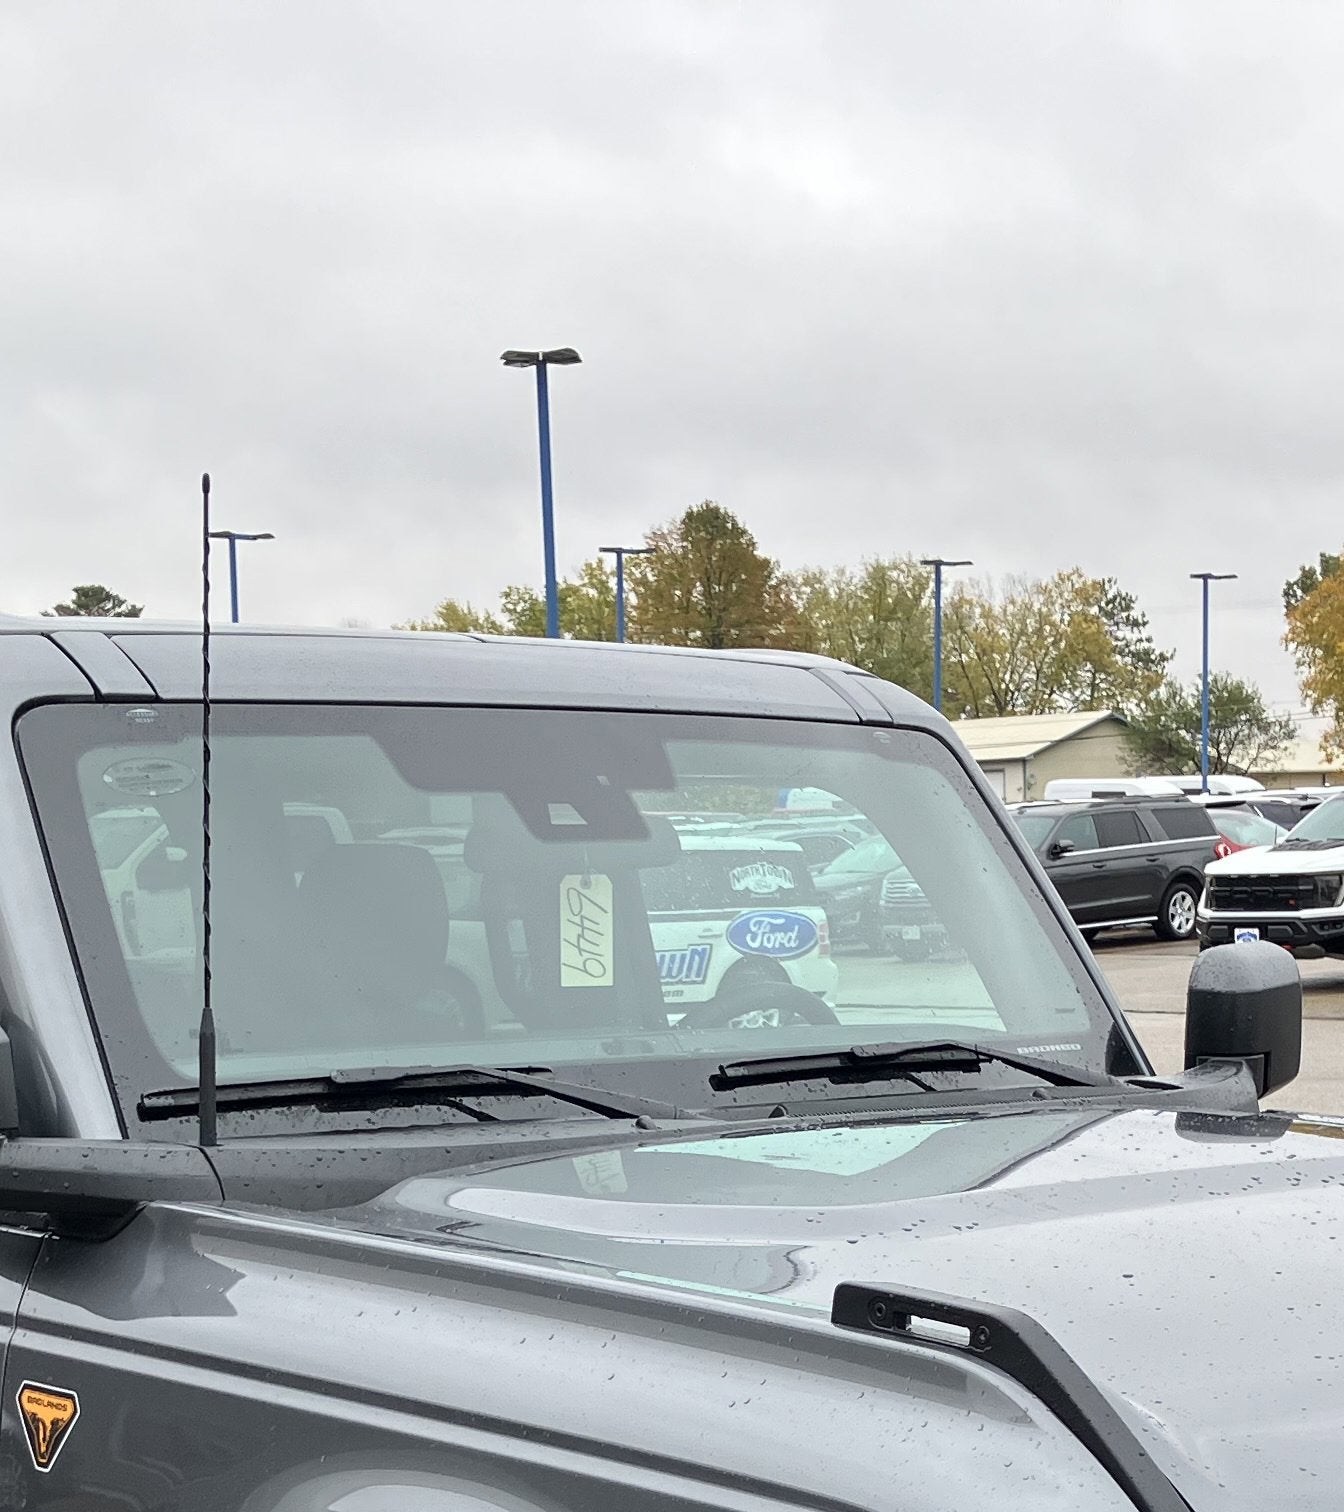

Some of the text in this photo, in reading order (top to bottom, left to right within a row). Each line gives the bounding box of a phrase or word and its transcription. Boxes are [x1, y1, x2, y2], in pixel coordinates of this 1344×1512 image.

[562, 887, 609, 979] 6449
[746, 917, 799, 948] Ford
[1016, 1043, 1082, 1055] BRONCO
